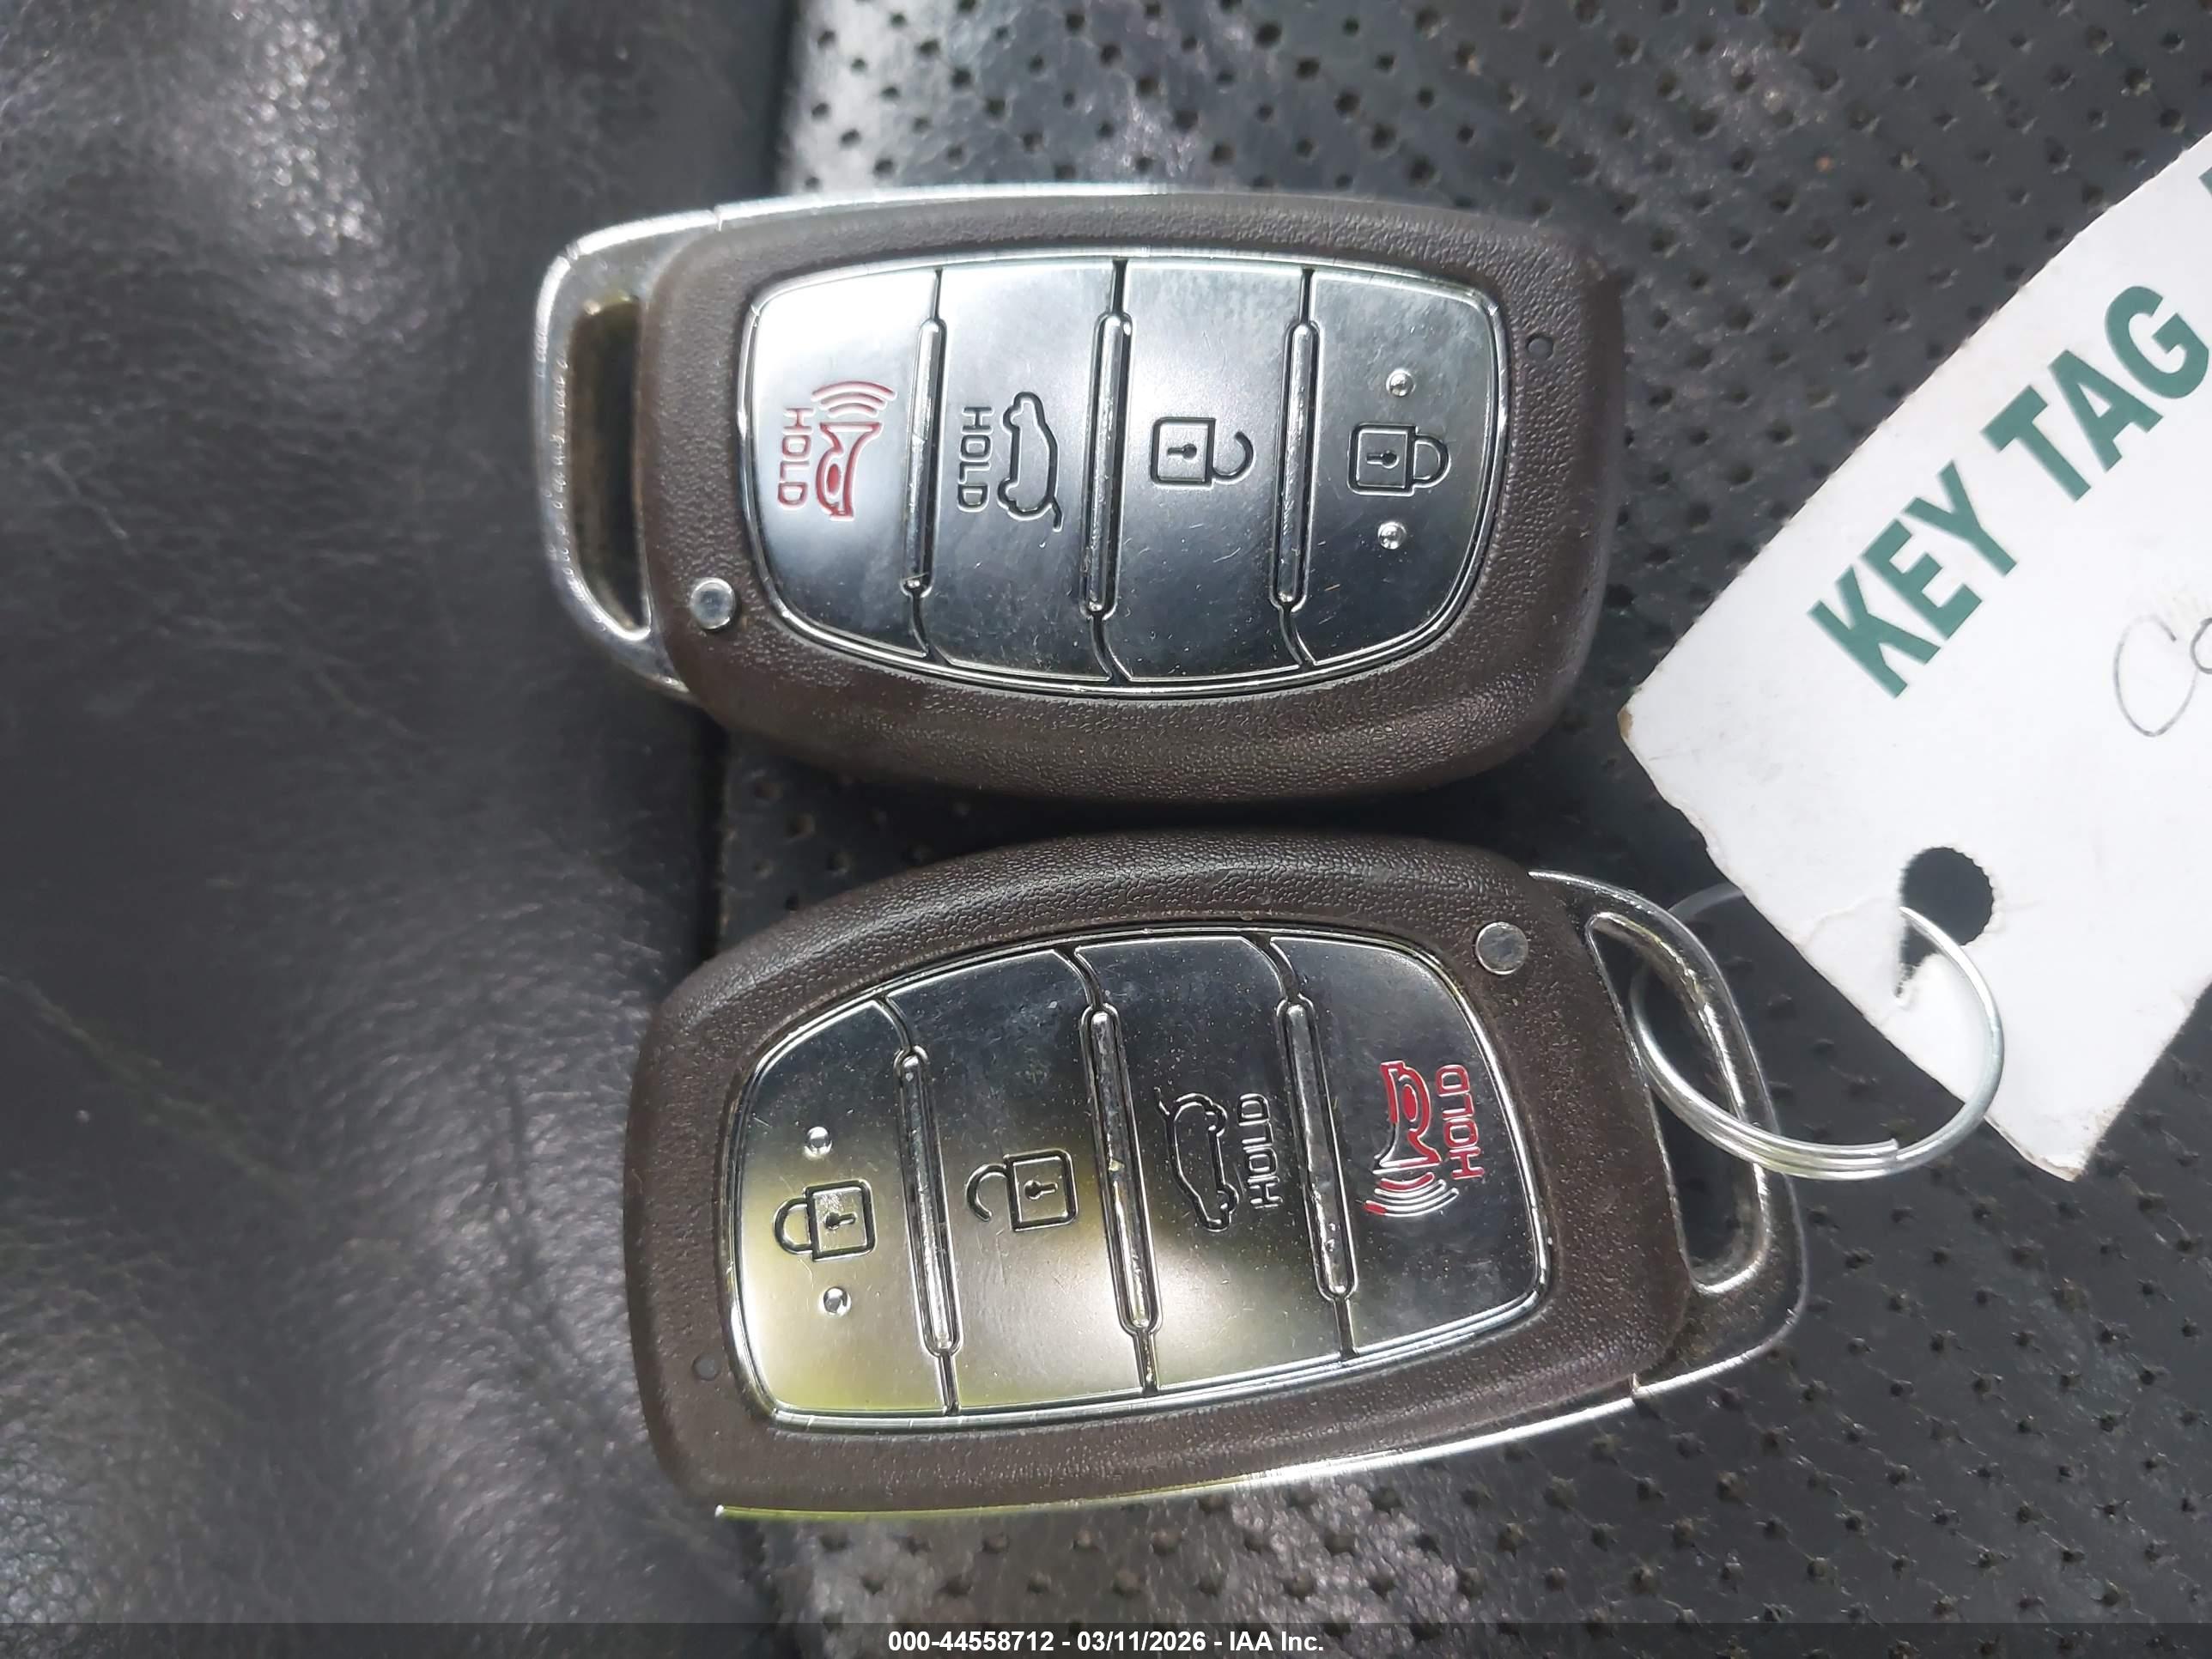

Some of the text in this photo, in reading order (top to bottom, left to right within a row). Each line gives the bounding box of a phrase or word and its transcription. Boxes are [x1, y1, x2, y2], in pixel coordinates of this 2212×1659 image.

[776, 406, 814, 510] HOLD
[957, 405, 994, 513] HOLD
[1805, 284, 2211, 700] KEY TAG
[1237, 1092, 1284, 1210] HOLD
[1435, 1064, 1486, 1181] HOLD
